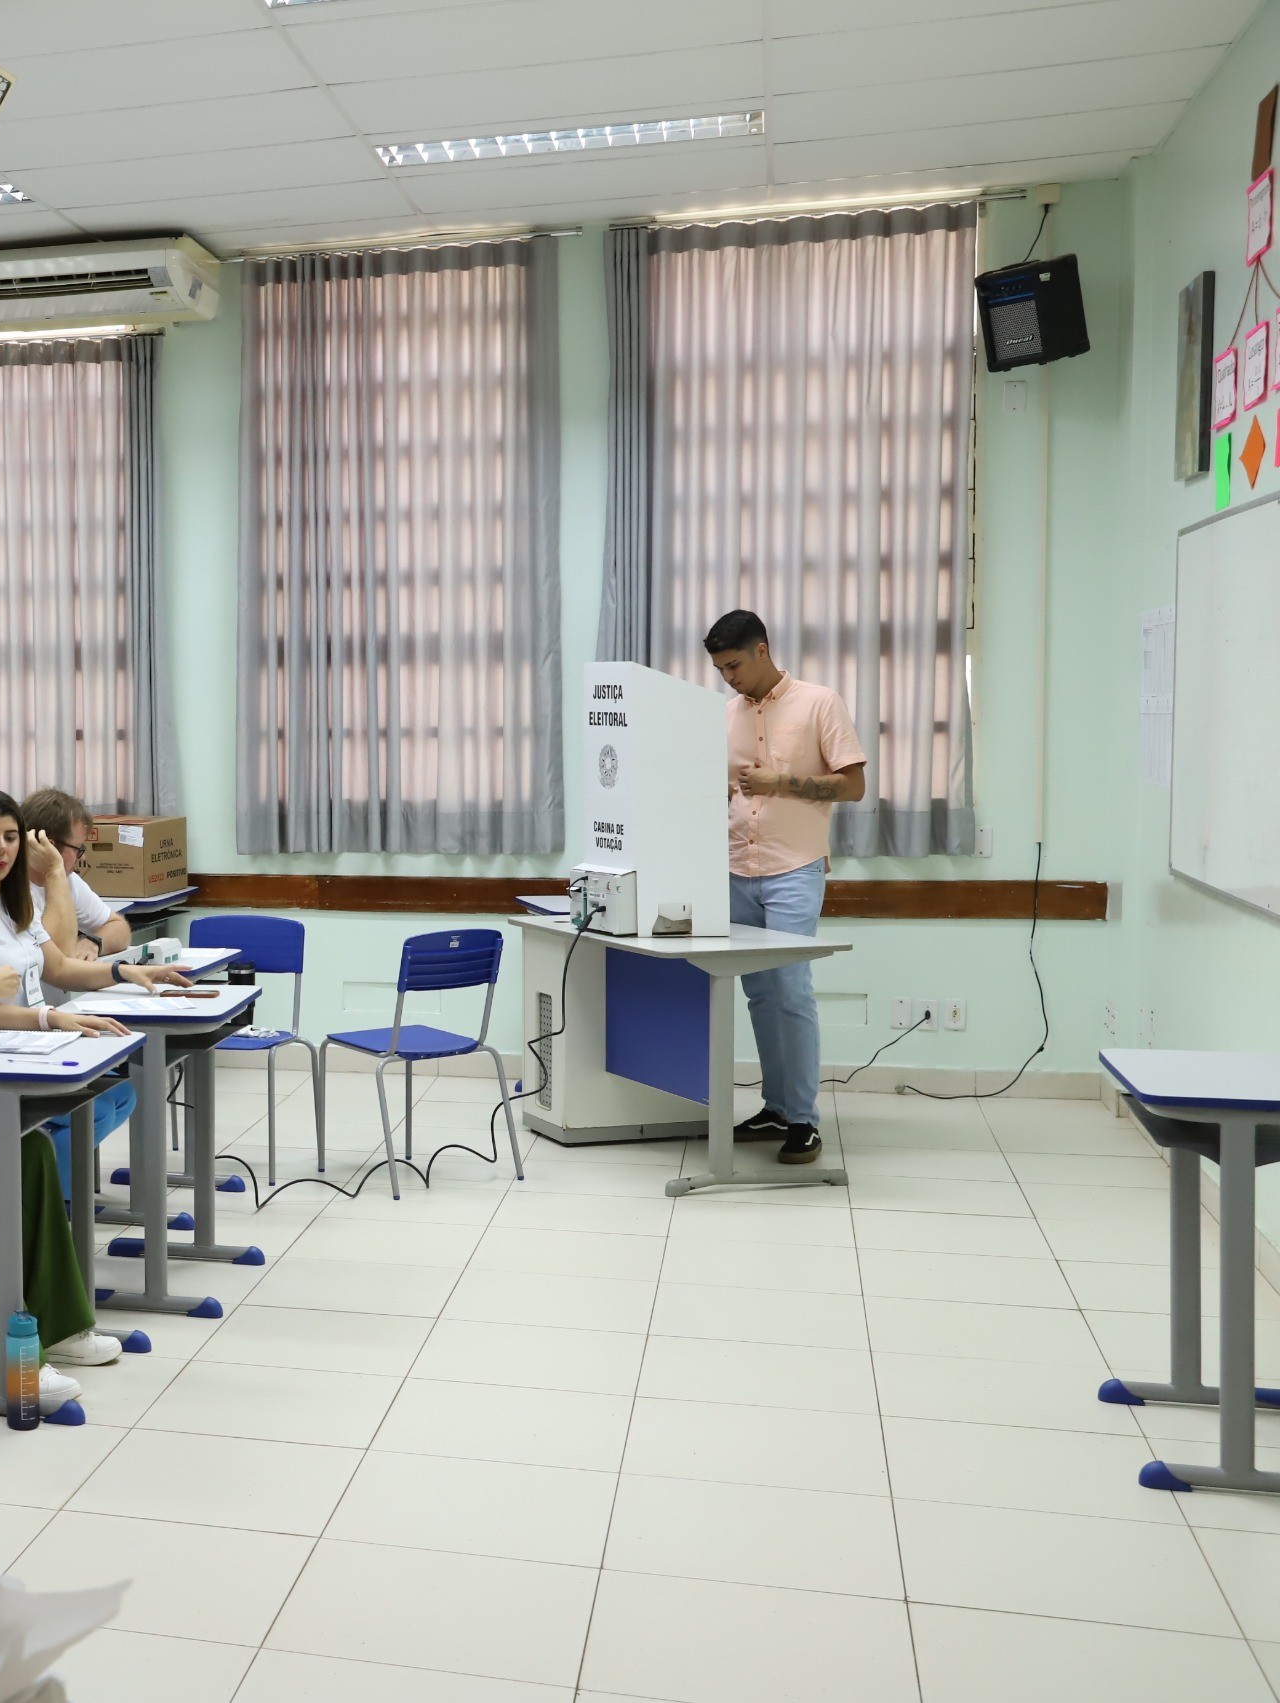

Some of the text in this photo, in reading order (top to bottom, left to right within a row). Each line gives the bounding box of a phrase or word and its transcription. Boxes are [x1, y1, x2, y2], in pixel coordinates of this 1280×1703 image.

[592, 684, 624, 704] JUSTIÇA
[588, 711, 628, 728] ELEITORAL
[593, 820, 624, 836] CABINA DE
[159, 838, 174, 849] URNA
[595, 836, 623, 853] VOTAÇÃO
